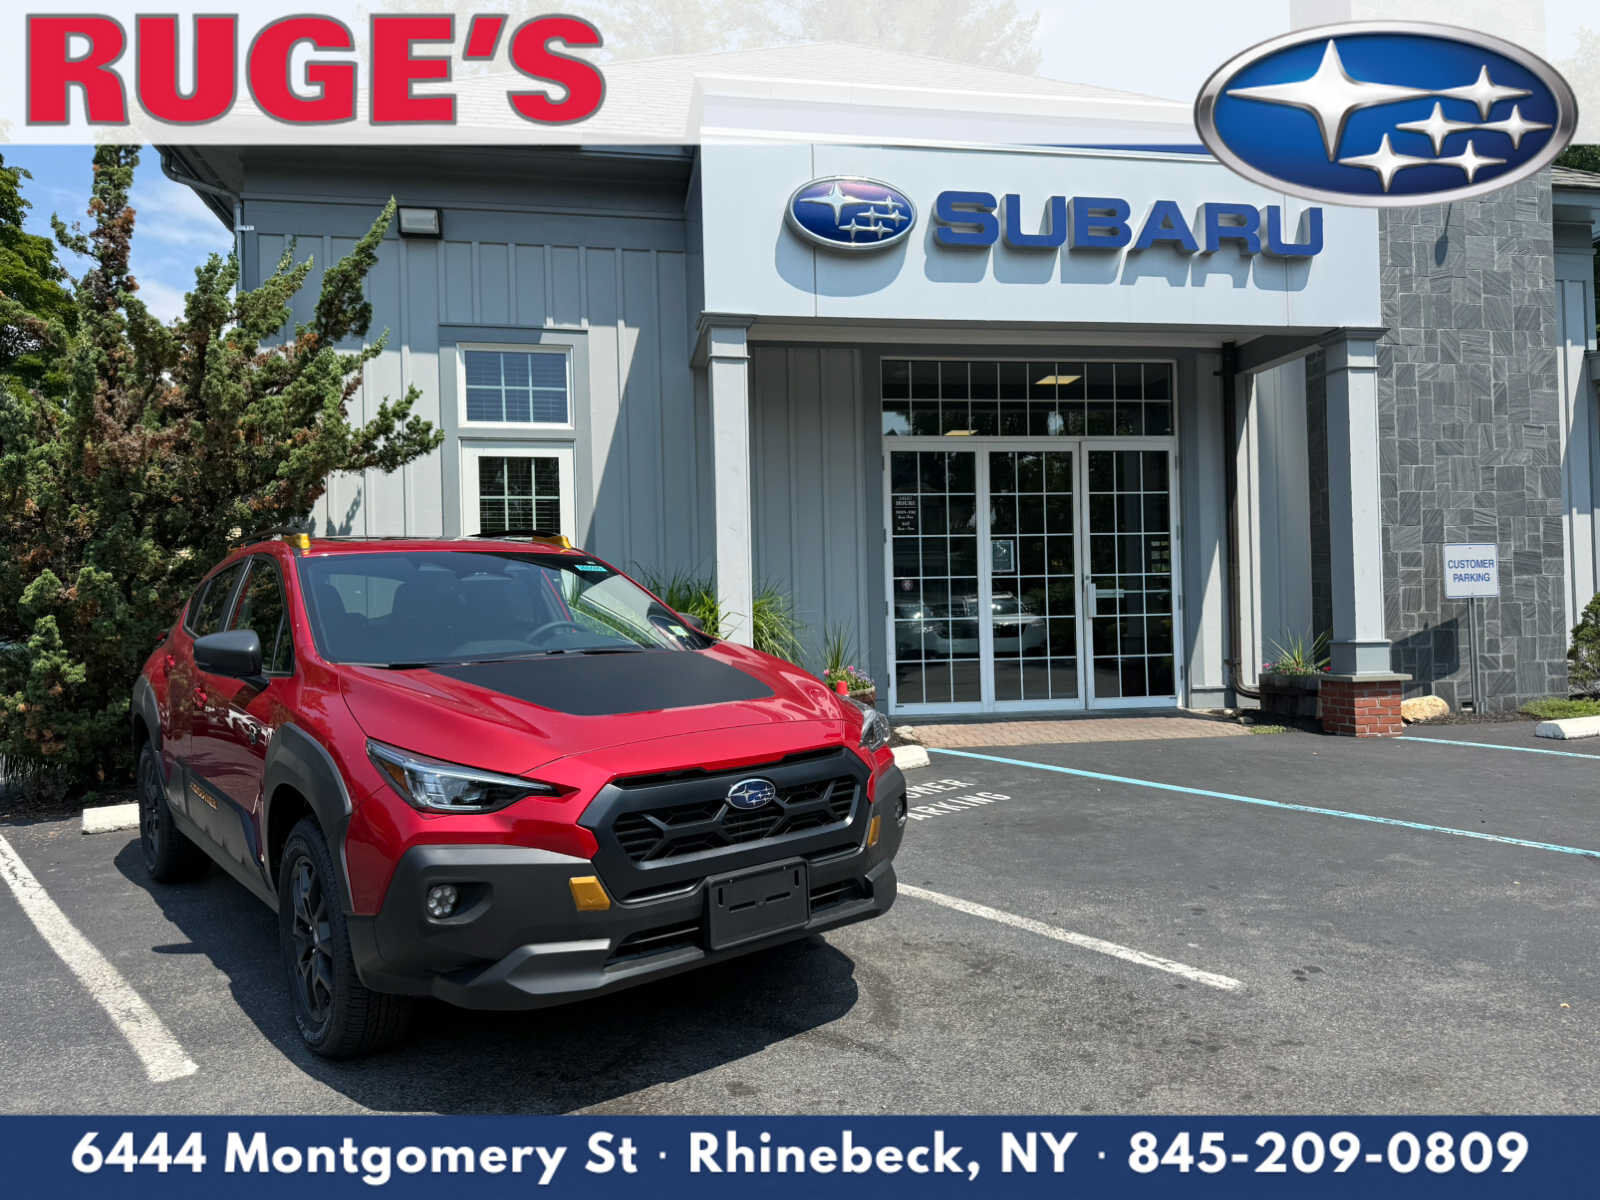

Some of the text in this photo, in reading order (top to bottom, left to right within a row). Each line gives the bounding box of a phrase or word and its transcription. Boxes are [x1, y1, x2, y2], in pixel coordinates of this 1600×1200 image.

[934, 190, 1324, 258] SUBARU
[1447, 559, 1495, 569] CUSTOMER
[1452, 572, 1491, 583] PARKING
